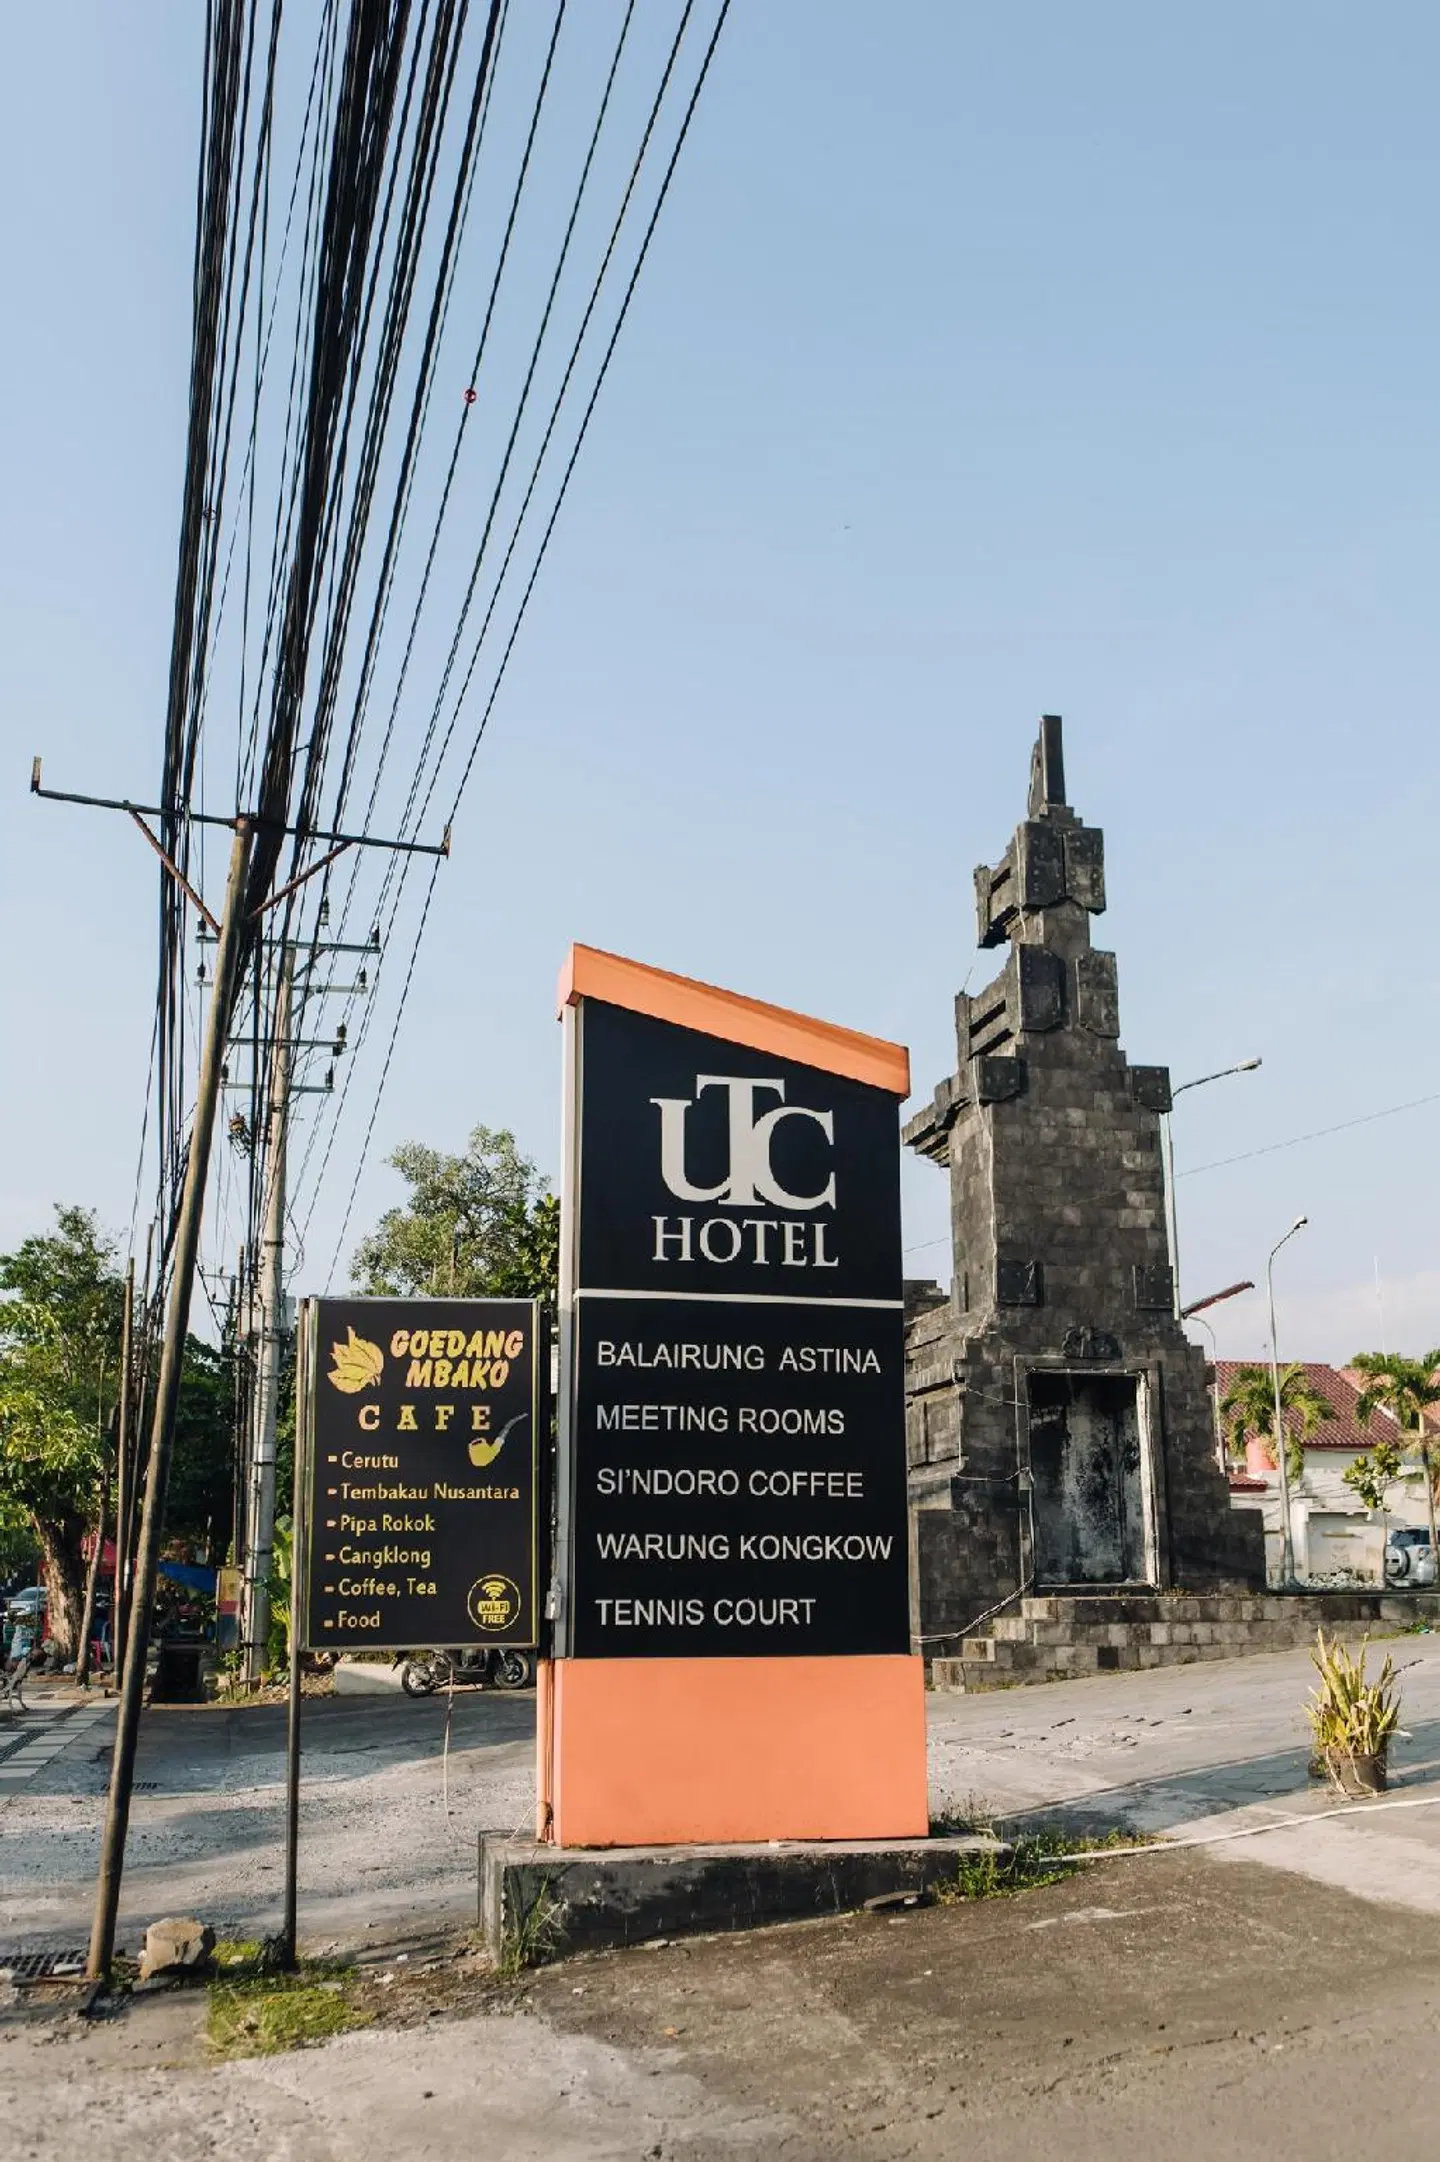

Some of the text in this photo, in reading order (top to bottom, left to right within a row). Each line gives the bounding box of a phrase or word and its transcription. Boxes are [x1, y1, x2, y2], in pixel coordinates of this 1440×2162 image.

[650, 1073, 837, 1210] UTC
[652, 1216, 838, 1266] HOTEL
[390, 1330, 524, 1359] GOEDANG
[598, 1341, 880, 1373] BALAIRUNG ASTINA
[405, 1359, 510, 1390] MBAKO
[359, 1405, 490, 1430] CAFE
[597, 1405, 844, 1434] MEETING ROOMS
[342, 1451, 398, 1468] Cerutu
[341, 1483, 519, 1499] Tembakau Nusantara
[749, 1471, 863, 1497] COFFEE
[341, 1514, 434, 1536] Pipa Rokok
[339, 1546, 430, 1569] Cangklong
[597, 1534, 892, 1559] WARUNG KONGKOW
[407, 1578, 436, 1594] Tea
[339, 1611, 379, 1628] Food
[482, 1614, 505, 1624] FREE
[595, 1599, 816, 1625] TENNIS COURT
